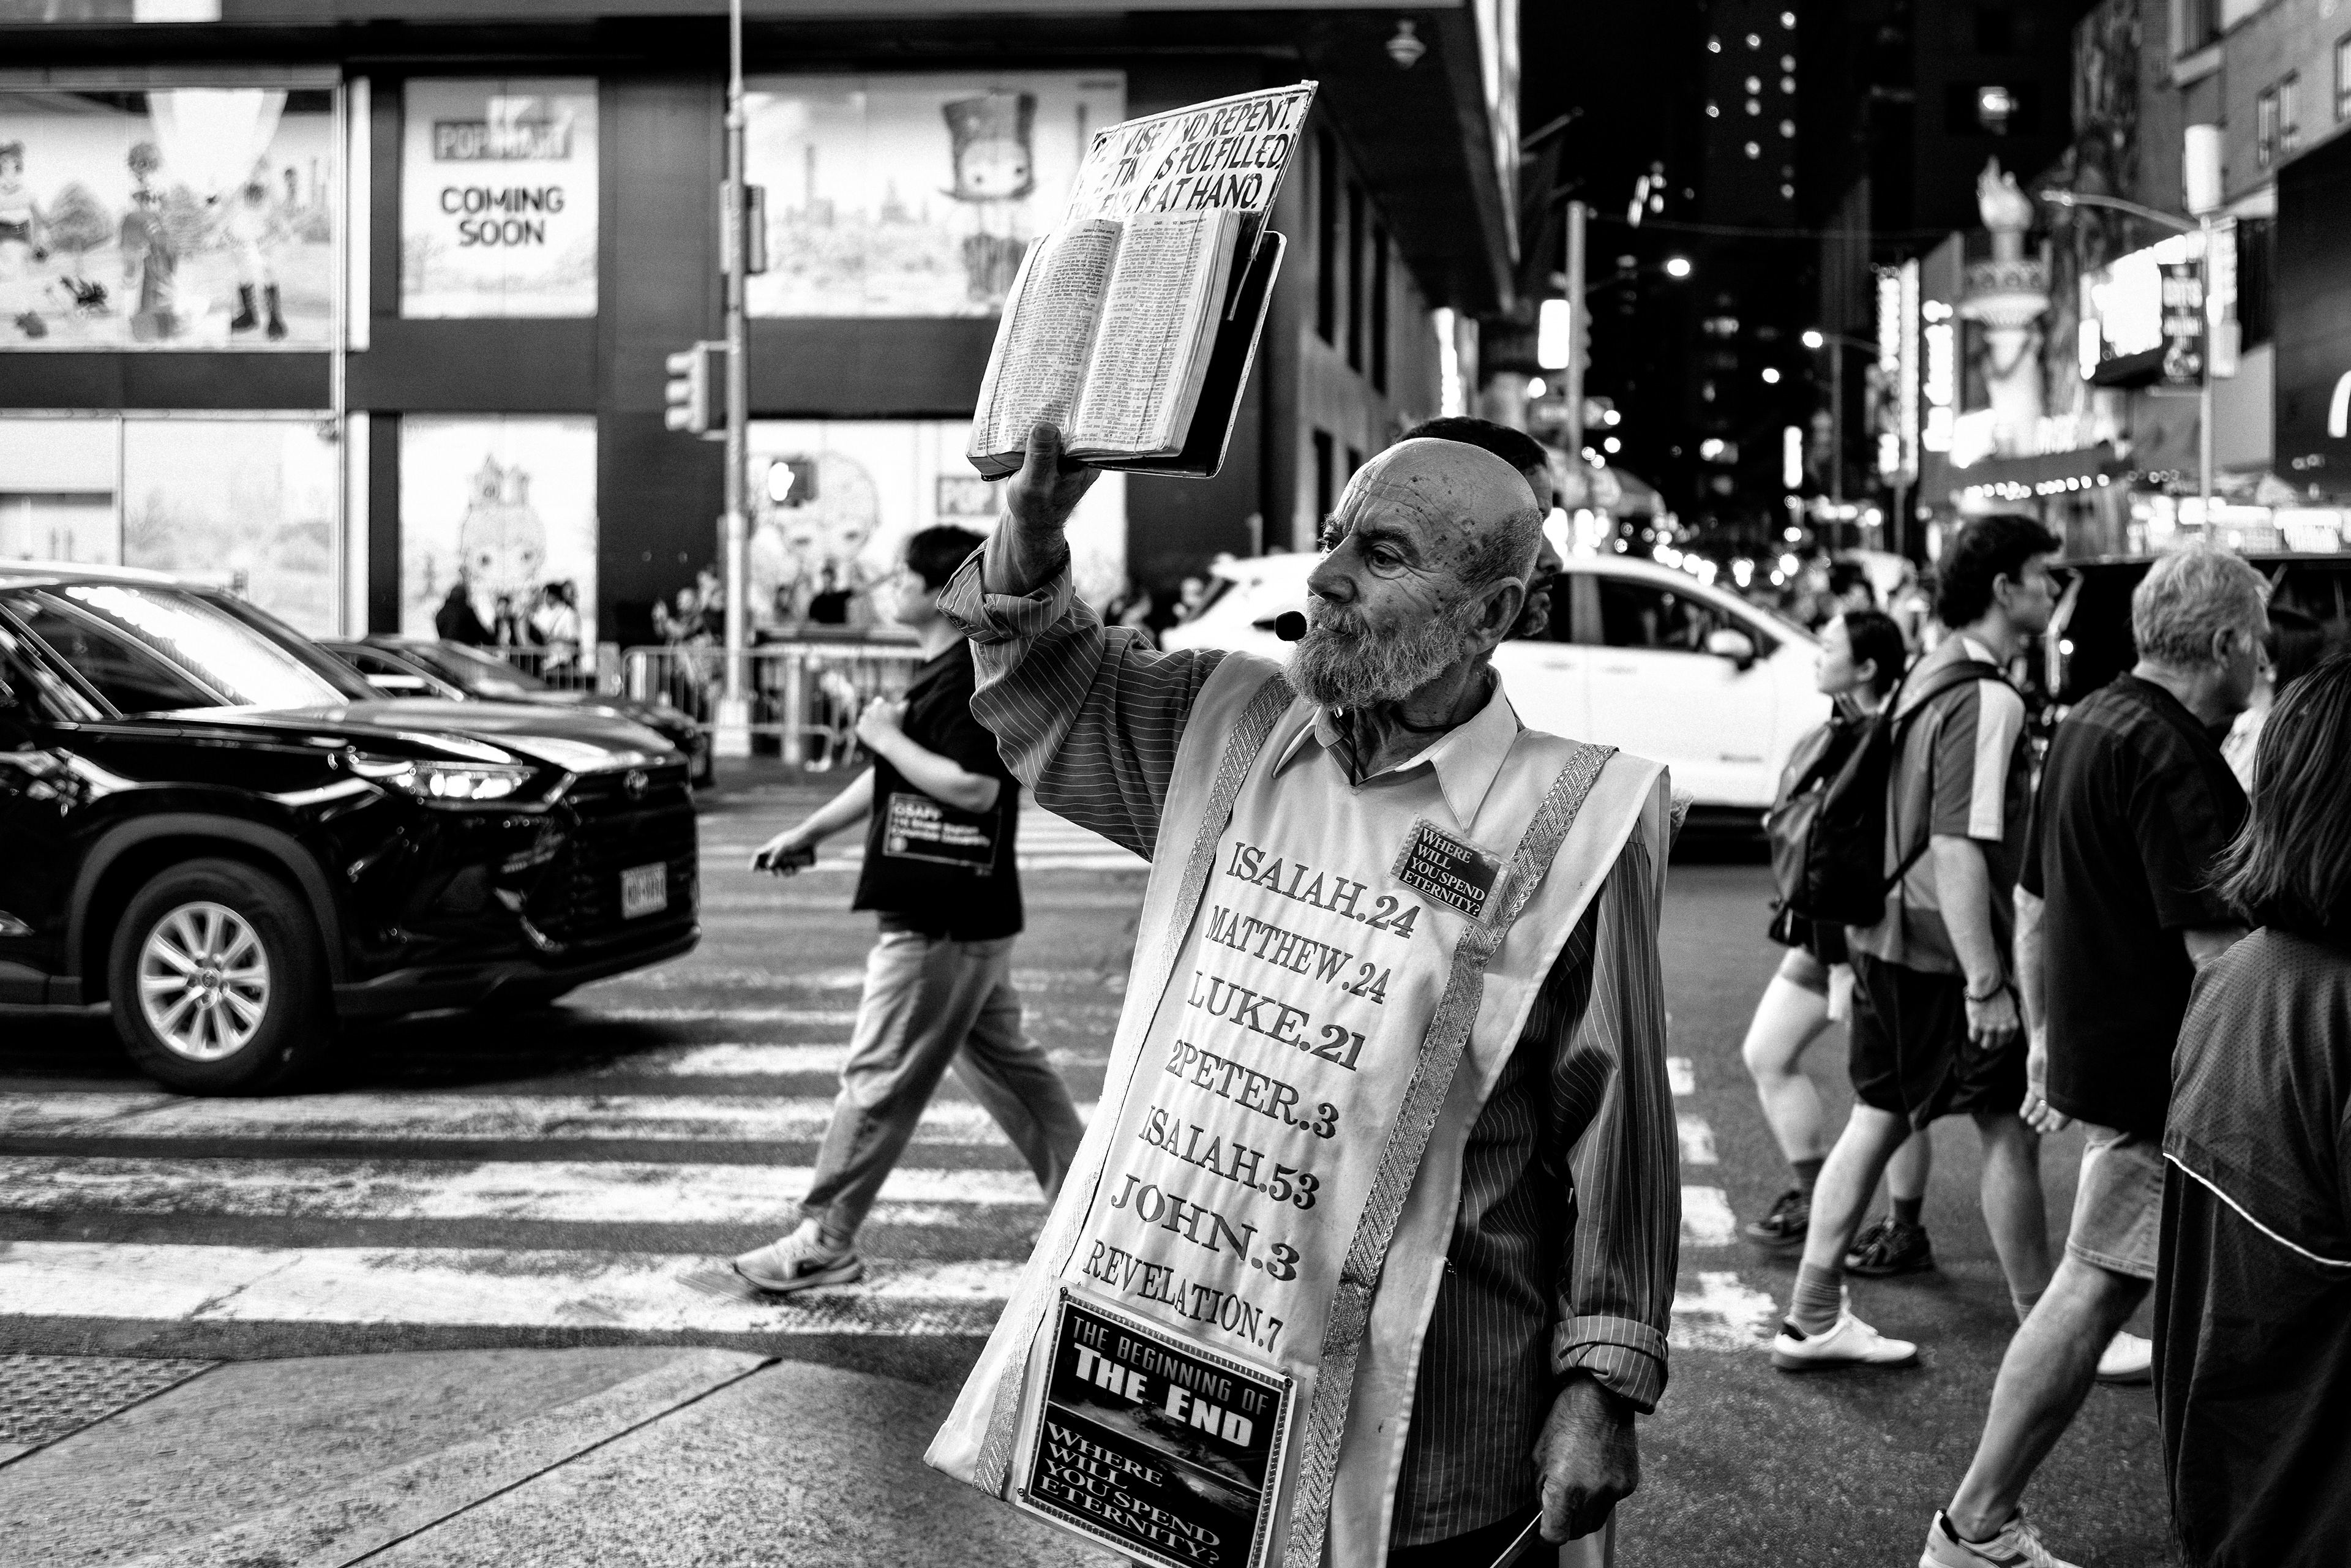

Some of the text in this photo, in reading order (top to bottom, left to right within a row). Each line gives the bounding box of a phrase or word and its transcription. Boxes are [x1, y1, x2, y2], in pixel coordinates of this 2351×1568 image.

[1204, 96, 1300, 139] REPENT.
[441, 186, 565, 215] COMING
[458, 218, 546, 247] SOON
[1150, 176, 1194, 213] AT
[1185, 173, 1263, 211] HAND.
[1226, 841, 1422, 939] ISAIAH.24
[1411, 856, 1486, 902] YOU SPEND
[1417, 843, 1452, 870] WILL
[1422, 827, 1473, 864] WHERE
[1402, 869, 1481, 916] ETERNITY?
[1205, 904, 1392, 1005] MATTHEW.24
[1187, 970, 1367, 1072] LUKE.21
[1164, 1039, 1340, 1139] 2PETER.3
[1138, 1105, 1321, 1210] ISAIAH.53
[1111, 1173, 1300, 1281] JOHN.3
[1082, 1239, 1284, 1353] REVELATION.7
[1073, 1315, 1269, 1416] THE BEGINNING OF
[1073, 1342, 1254, 1447] THE END
[1046, 1420, 1163, 1487] WHERE
[1048, 1441, 1128, 1490] WILL
[1041, 1474, 1220, 1566] ETERNITY?
[1044, 1458, 1221, 1547] YOU SPEND
